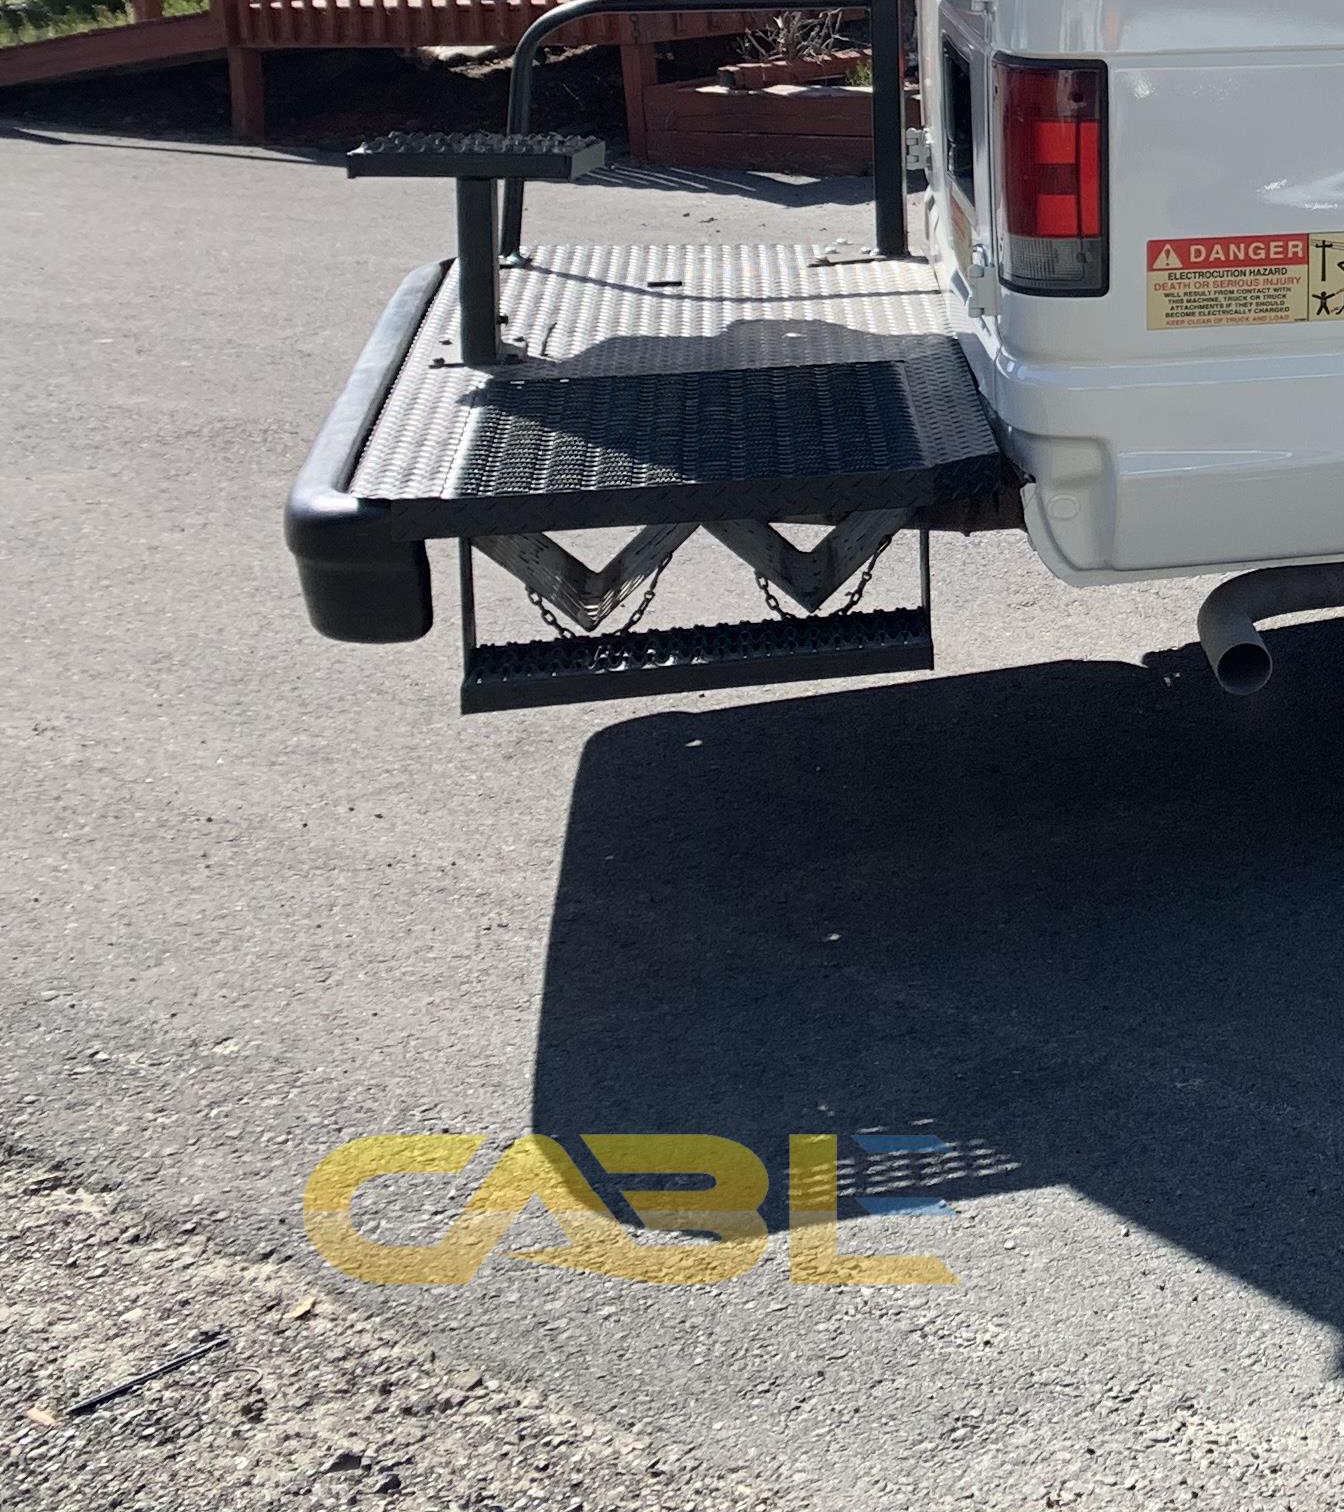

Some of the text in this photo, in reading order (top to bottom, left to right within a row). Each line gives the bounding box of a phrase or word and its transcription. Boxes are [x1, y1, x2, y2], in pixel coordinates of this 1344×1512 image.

[1190, 240, 1303, 263] DANGER
[1167, 267, 1288, 281] ELECTROCUTION HAZARD
[1154, 276, 1302, 292] DEATH OR SERIOUS INJURY
[1170, 303, 1224, 311] ATTACHMENTS
